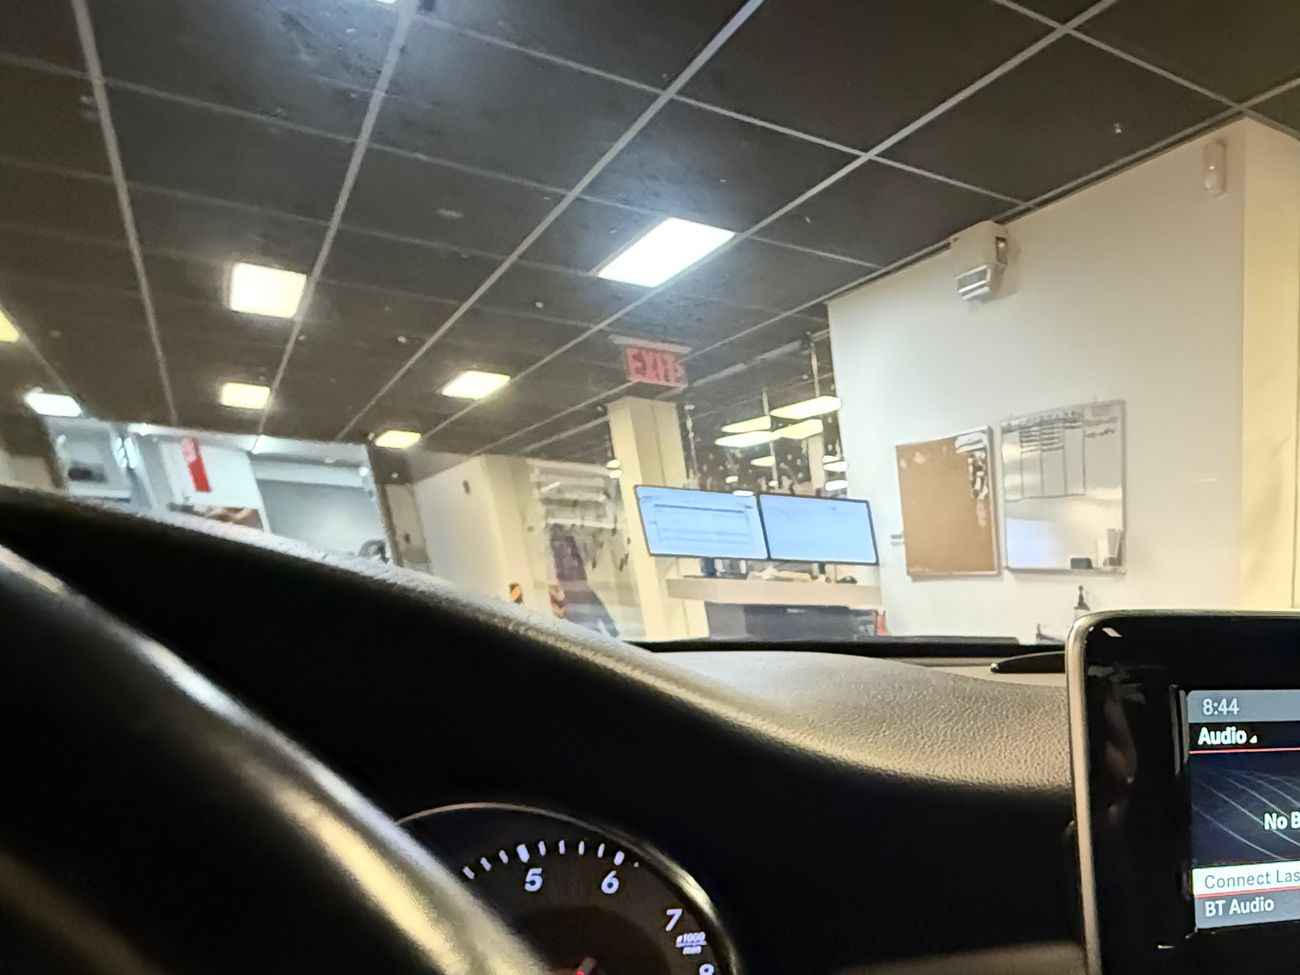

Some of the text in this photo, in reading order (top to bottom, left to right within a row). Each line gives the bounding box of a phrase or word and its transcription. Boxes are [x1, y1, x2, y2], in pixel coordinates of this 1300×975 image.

[1202, 697, 1240, 716] 8:44
[1198, 726, 1247, 745] Audio
[1263, 812, 1288, 831] No
[524, 867, 544, 892] 5
[600, 871, 620, 895] 6
[1204, 871, 1271, 890] Connect
[1204, 898, 1275, 917] BT Audio
[665, 908, 683, 932] 7
